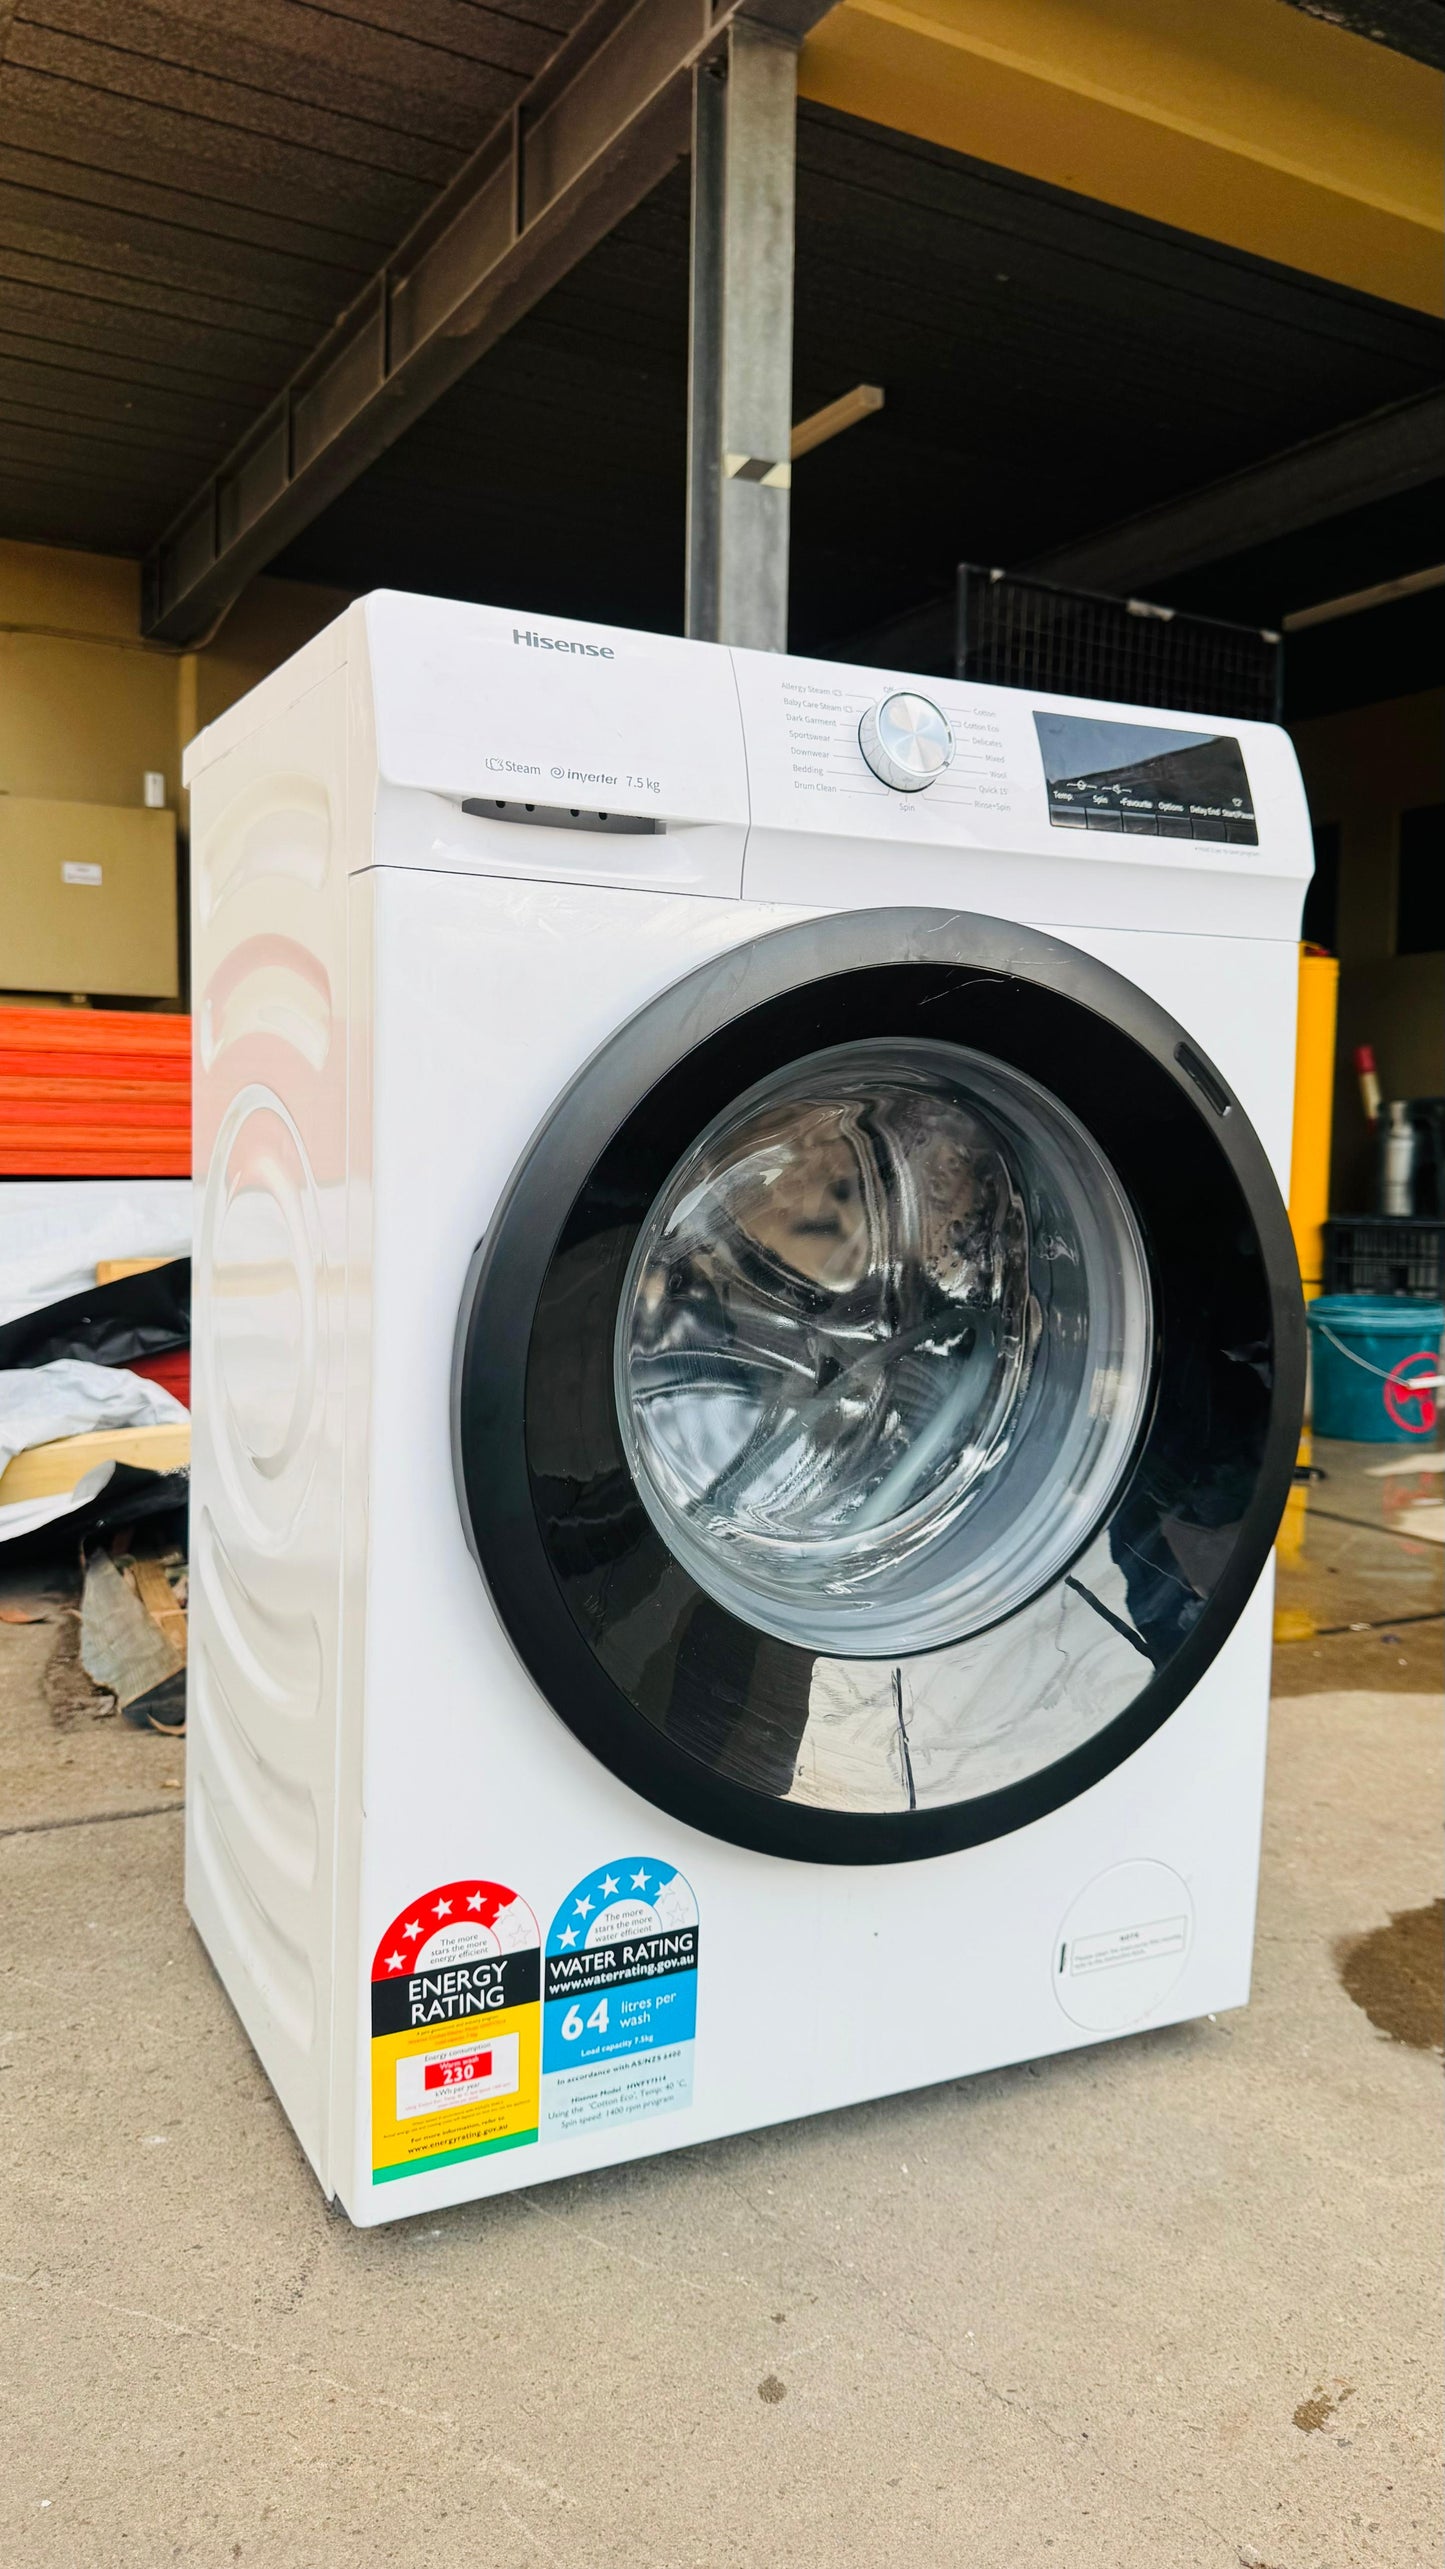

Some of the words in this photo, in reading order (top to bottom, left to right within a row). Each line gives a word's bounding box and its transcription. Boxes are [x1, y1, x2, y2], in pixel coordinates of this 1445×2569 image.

[513, 629, 615, 660] Hisense
[781, 682, 806, 693] Allergy
[807, 686, 831, 695] Steam
[783, 698, 801, 708] Baby
[802, 700, 819, 709] Care
[820, 703, 842, 712] Steam
[786, 713, 803, 722] Dark
[804, 716, 837, 727] Garment
[973, 708, 997, 718] Cotton
[963, 721, 986, 731] Cotton
[788, 730, 831, 743] Sportswear
[972, 737, 1003, 748] Delicates
[790, 746, 830, 759] Downwear
[985, 753, 1006, 764] Mixed
[505, 760, 541, 775] Steam
[792, 764, 824, 776] Bedding
[567, 768, 618, 784] inverter
[625, 776, 644, 788] 7.5
[646, 778, 661, 794] kg
[794, 781, 815, 791] Drum
[816, 783, 837, 793] Clean
[979, 785, 998, 794] Quick
[1053, 790, 1074, 801] Temp.
[899, 802, 916, 812] Spin
[1092, 794, 1109, 805] Spin
[1158, 801, 1184, 812] Options
[605, 1913, 621, 1922] The
[622, 1909, 643, 1919] more
[595, 1925, 614, 1933] stars
[617, 1921, 630, 1929] the
[632, 1916, 653, 1926] more
[457, 1934, 479, 1943] more
[595, 1932, 617, 1942] water
[620, 1925, 652, 1937] efficient
[430, 1954, 456, 1964] energy
[458, 1947, 489, 1958] efficient
[431, 1948, 450, 1956] stars
[466, 1940, 488, 1949] more
[550, 1950, 617, 1979] WATER
[623, 1933, 694, 1965] RATING
[408, 1960, 508, 2002] ENERGY
[549, 1954, 695, 1995] www.waterrating.gov.au
[411, 1986, 505, 2025] RATING
[561, 1998, 609, 2041] 64
[621, 1998, 652, 2014] litres
[655, 1992, 677, 2009] per
[620, 2011, 651, 2028] wash
[425, 2052, 447, 2062] Energy
[449, 2042, 491, 2056] consumption
[581, 2045, 600, 2057] Load
[601, 2039, 632, 2052] capacity
[440, 2060, 462, 2071] Warm
[463, 2055, 480, 2064] wash
[567, 2068, 611, 2084] accordance
[613, 2064, 630, 2072] with
[631, 2055, 661, 2069] AS/NZS
[443, 2064, 475, 2086] 230
[435, 2087, 452, 2097] kWh
[453, 2086, 465, 2095] per
[467, 2082, 480, 2091] year
[548, 2110, 570, 2120] Using
[571, 2106, 583, 2115] the
[561, 2118, 578, 2129] Spin
[606, 2105, 624, 2117] 1400
[625, 2103, 642, 2113] rpm
[643, 2094, 675, 2108] program
[407, 2123, 509, 2154] www.energyrating.gov.au
[423, 2132, 441, 2140] more
